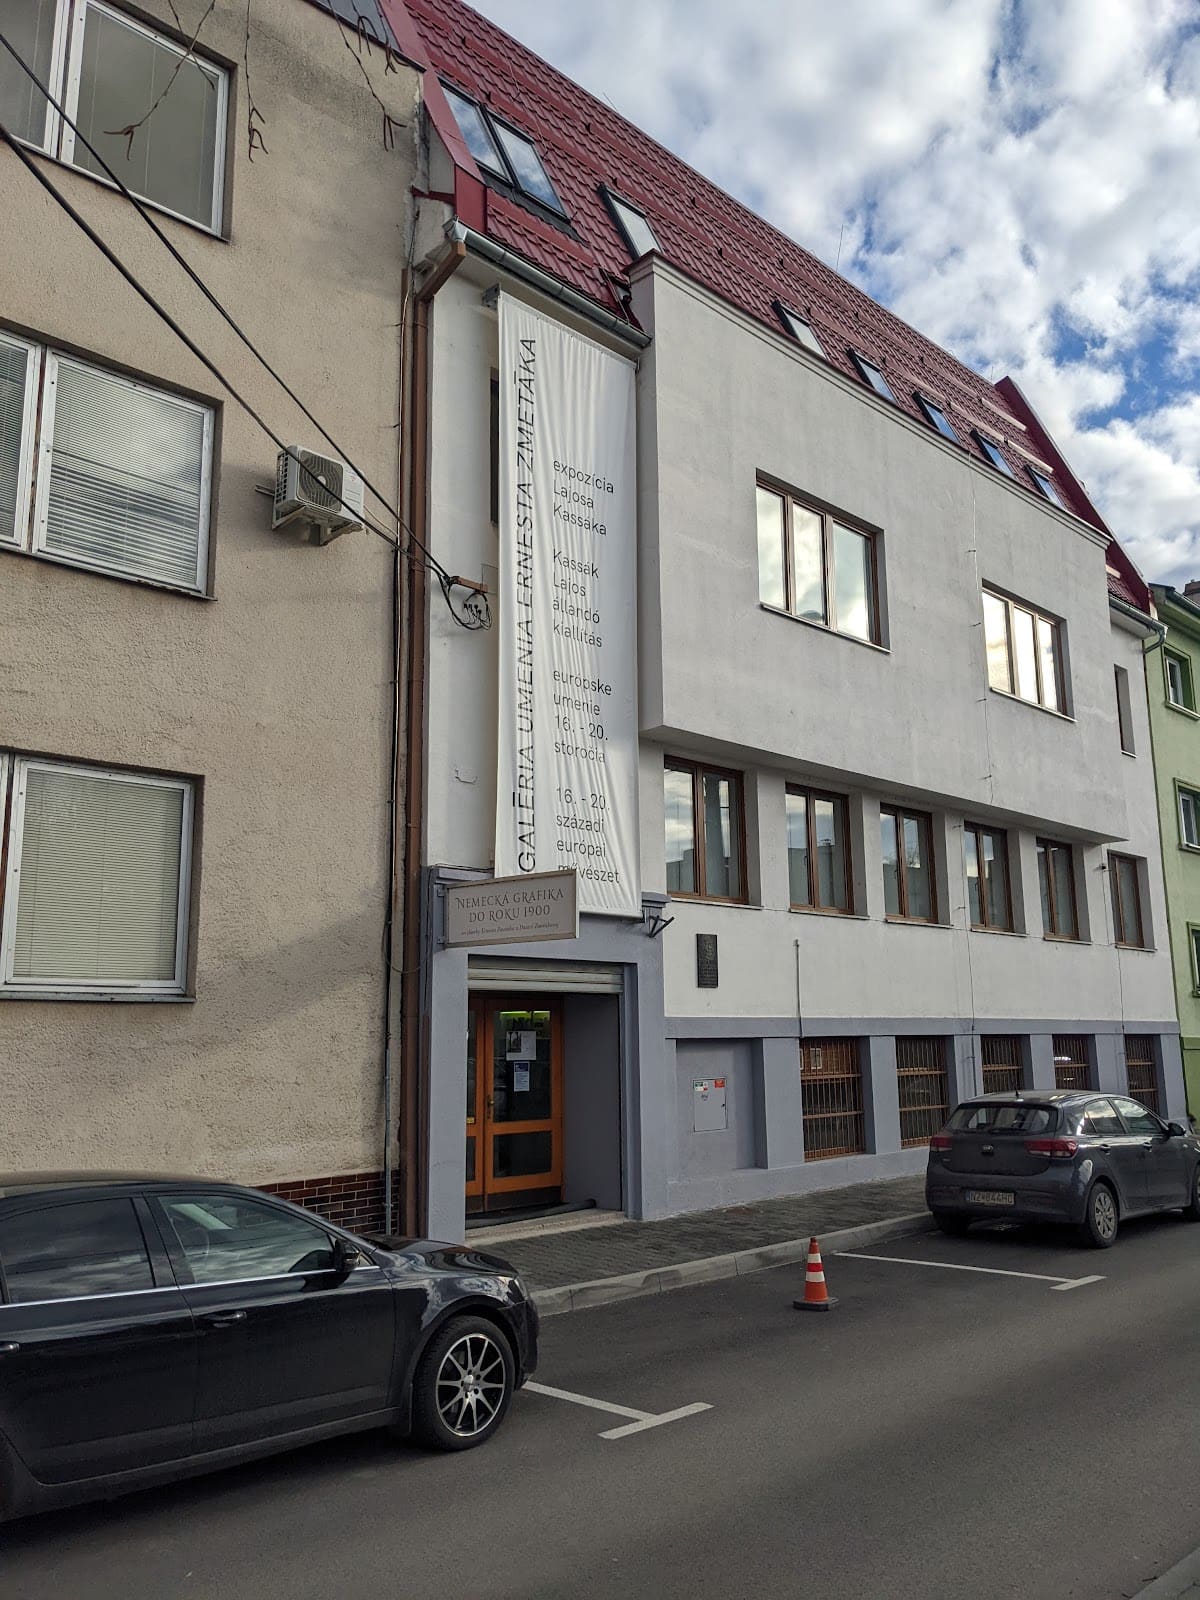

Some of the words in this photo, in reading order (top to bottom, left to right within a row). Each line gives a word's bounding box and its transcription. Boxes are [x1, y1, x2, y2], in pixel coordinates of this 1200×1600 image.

[553, 460, 614, 494] expozícia
[553, 480, 594, 509] Lajosa
[553, 502, 607, 536] Kassáka
[516, 483, 533, 608] ERNESTA
[554, 548, 600, 579] Kassák
[554, 571, 586, 597] Lajos
[553, 596, 600, 624] állandó
[517, 620, 533, 733] UMENIA
[553, 670, 612, 696] európske
[553, 693, 601, 716] umenie
[555, 714, 575, 733] 16.
[589, 722, 608, 741] 20.
[556, 786, 577, 805] 16.
[591, 793, 610, 811] 20.
[556, 813, 605, 833] századi
[557, 839, 606, 859] európai
[513, 887, 564, 904] GRAFIKA
[469, 911, 485, 923] DO
[489, 907, 520, 922] ROKU
[524, 904, 551, 917] 1900
